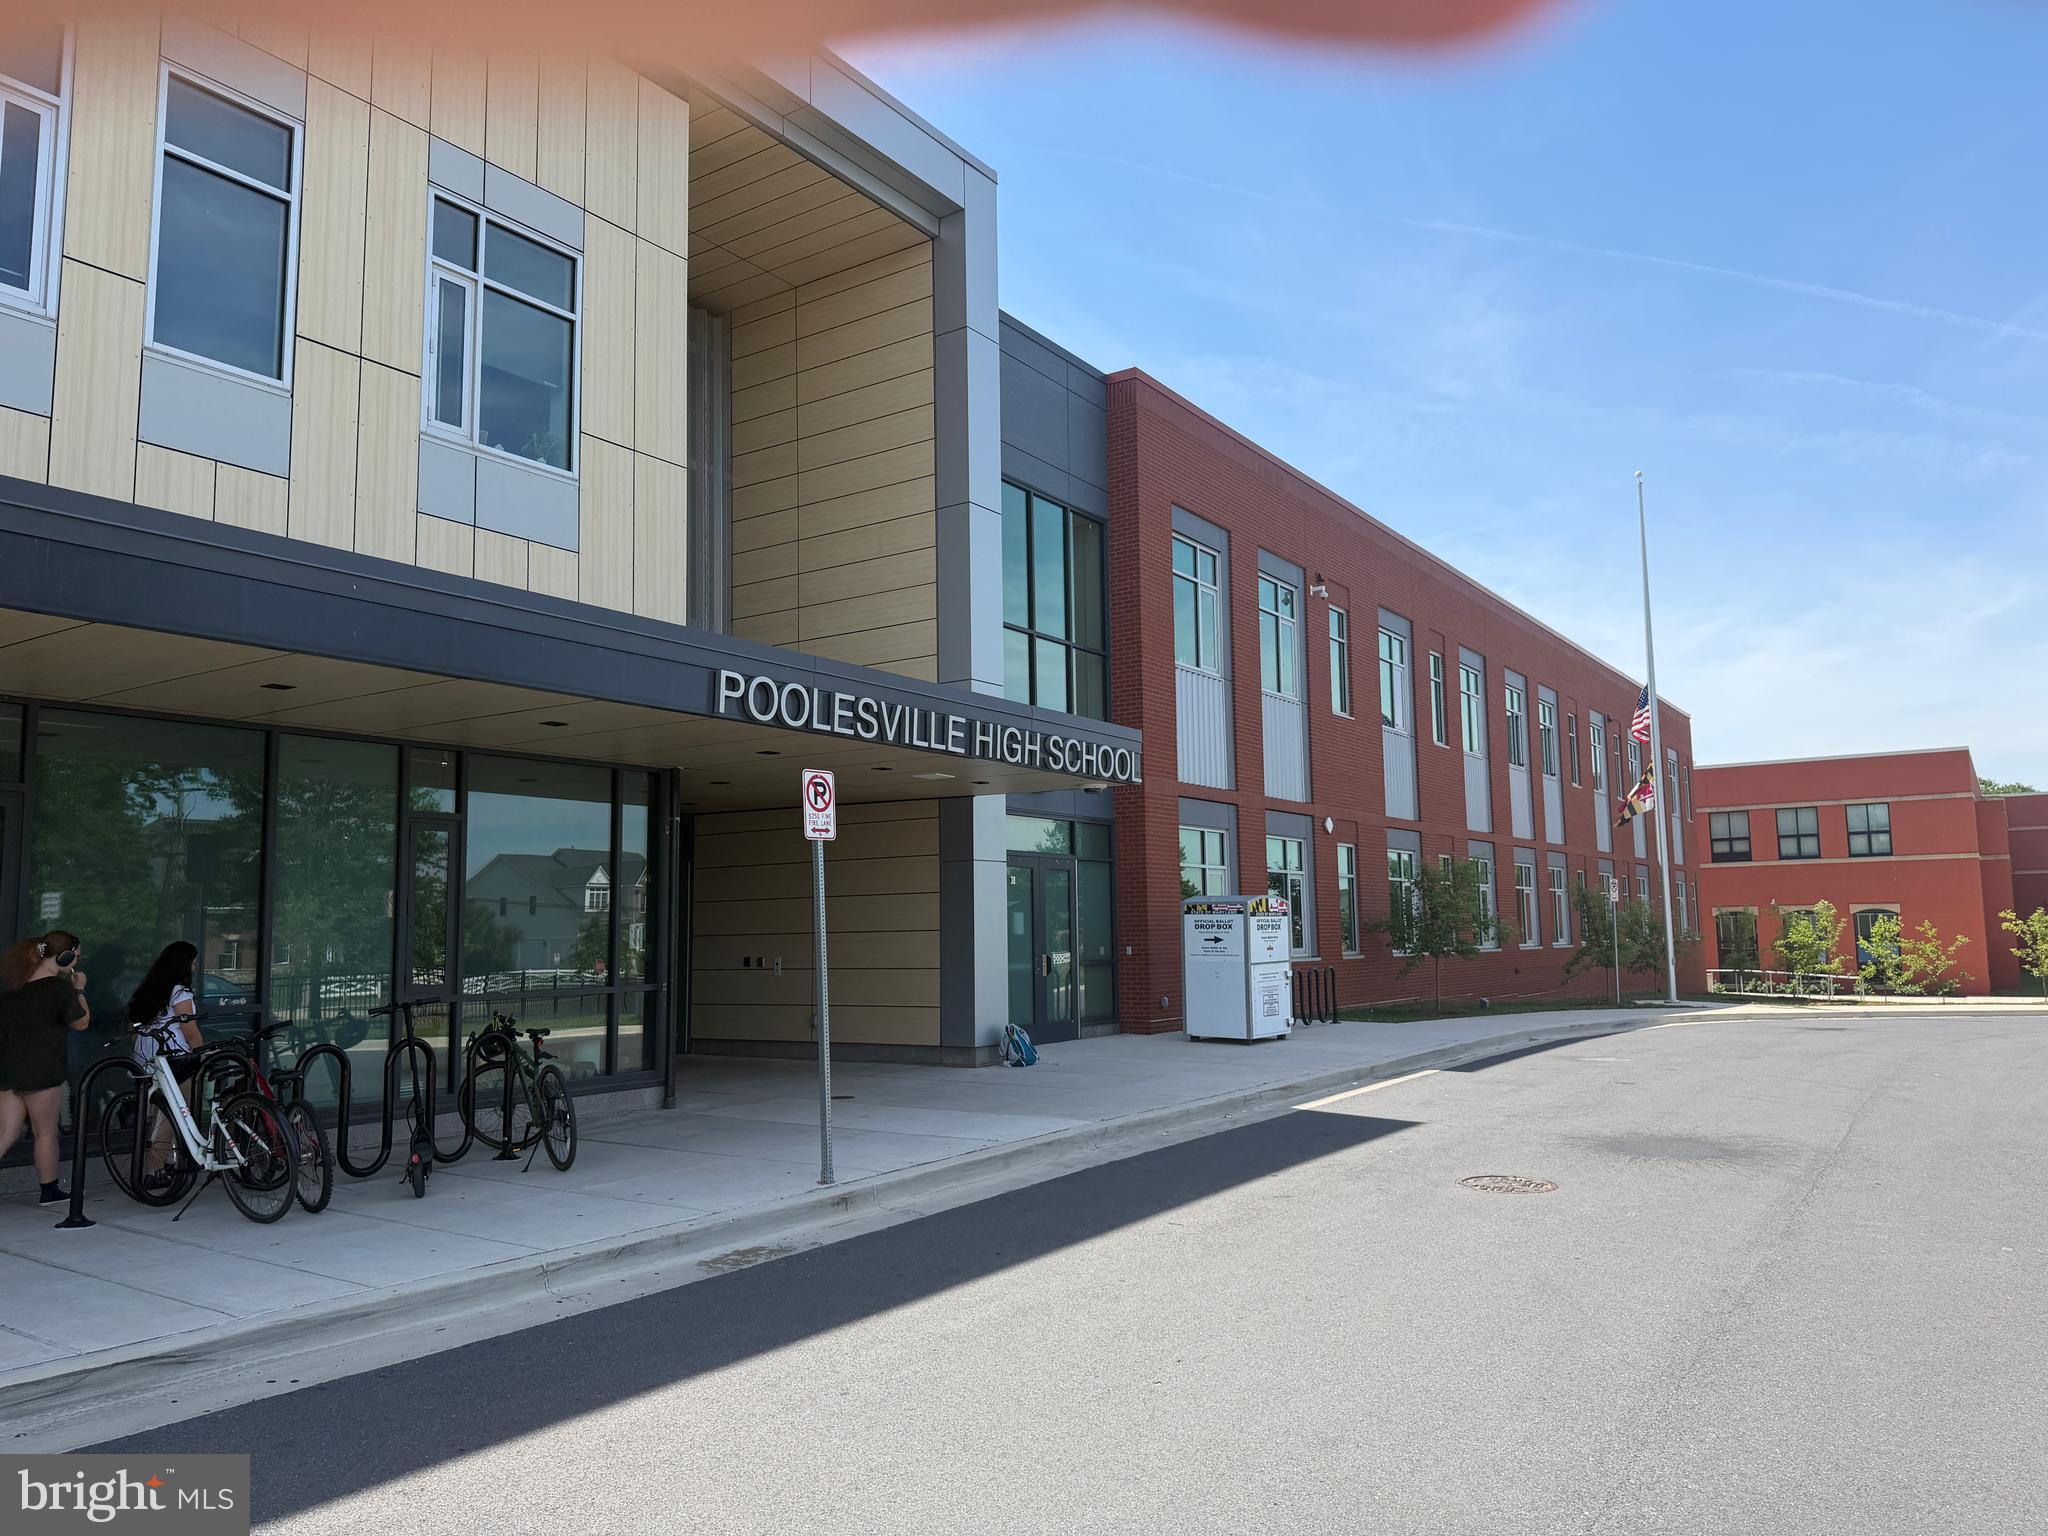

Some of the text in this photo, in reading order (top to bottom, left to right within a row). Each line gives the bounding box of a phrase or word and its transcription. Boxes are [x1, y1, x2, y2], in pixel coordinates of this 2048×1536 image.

[717, 669, 1143, 784] POOLESVILLE HIGH SCHOOL
[808, 819, 818, 827] FIRE
